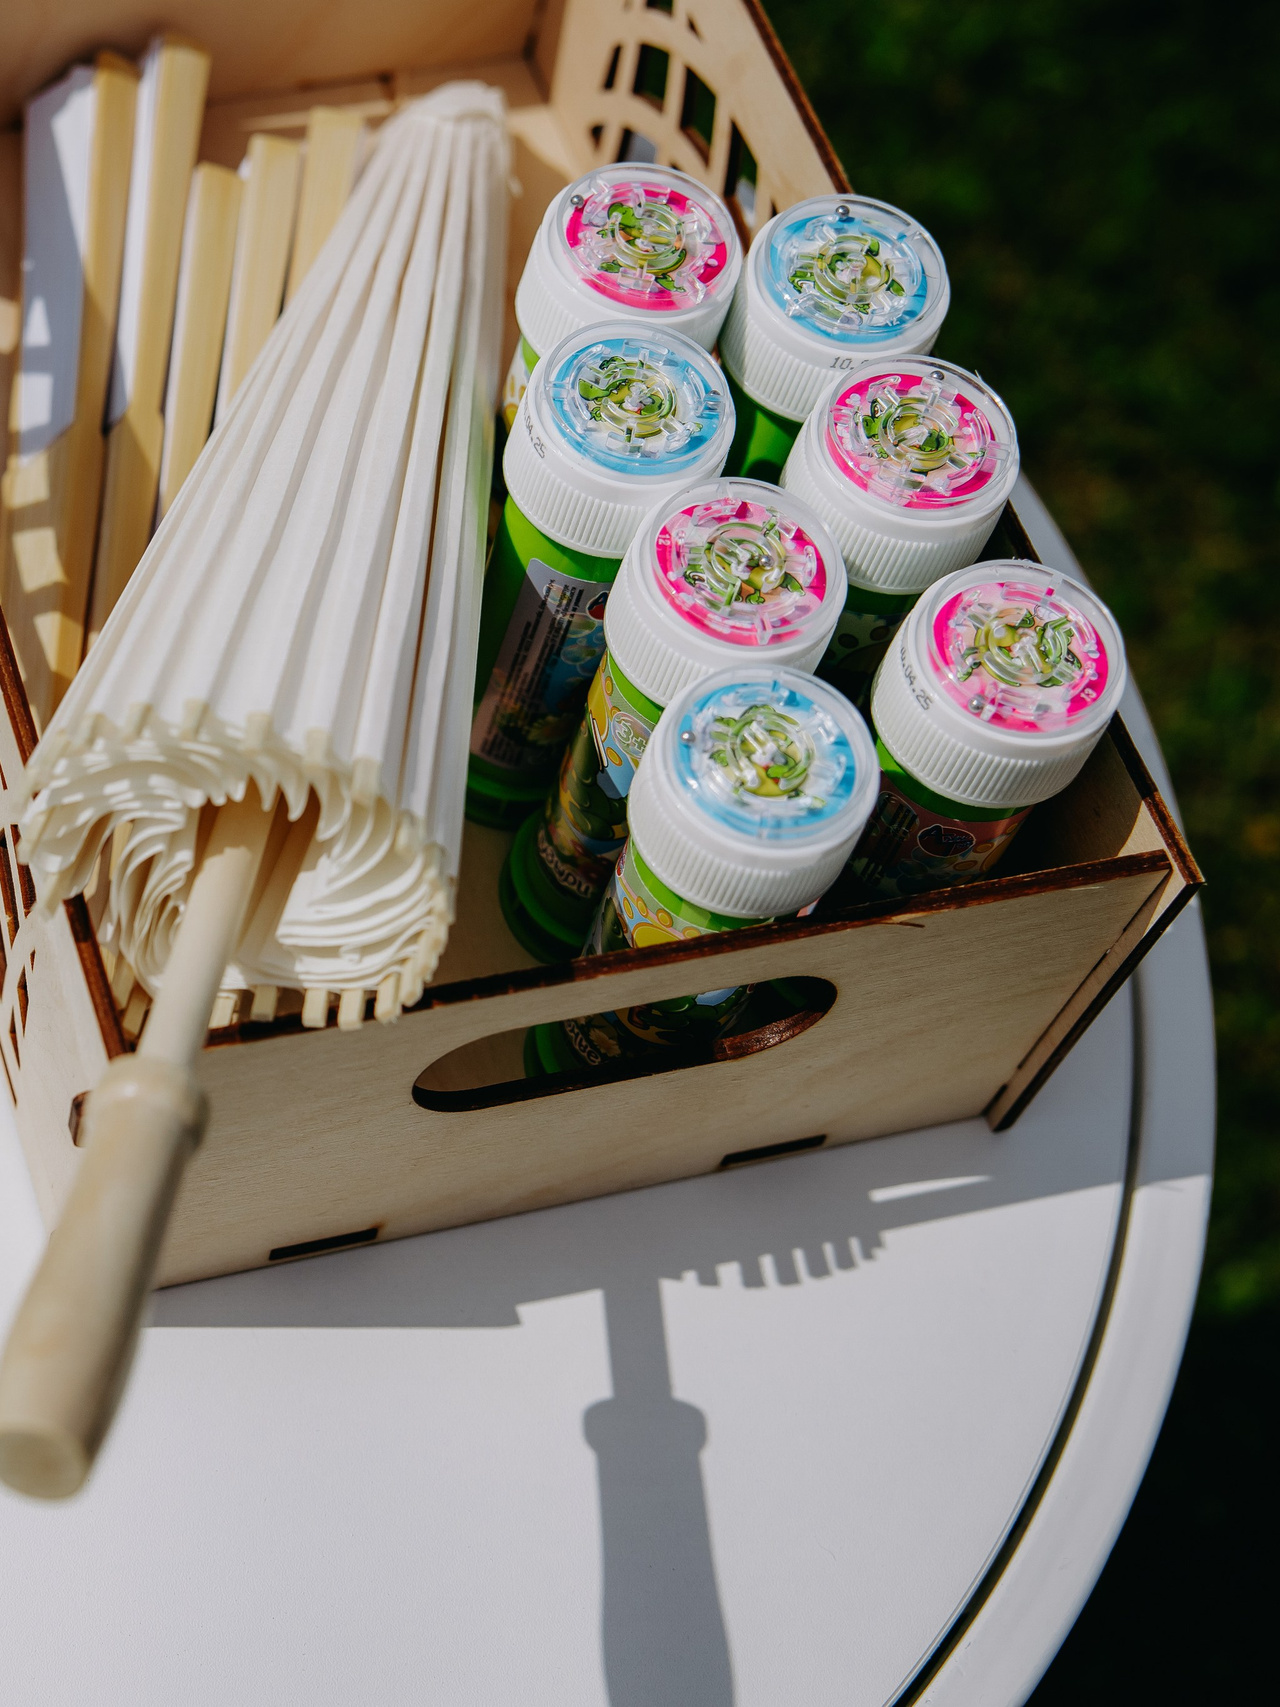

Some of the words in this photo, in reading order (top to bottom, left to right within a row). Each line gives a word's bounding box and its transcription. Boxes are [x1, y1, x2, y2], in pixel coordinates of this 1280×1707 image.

[657, 534, 671, 546] 12
[1080, 687, 1097, 701] 13
[615, 716, 648, 752] 3+
